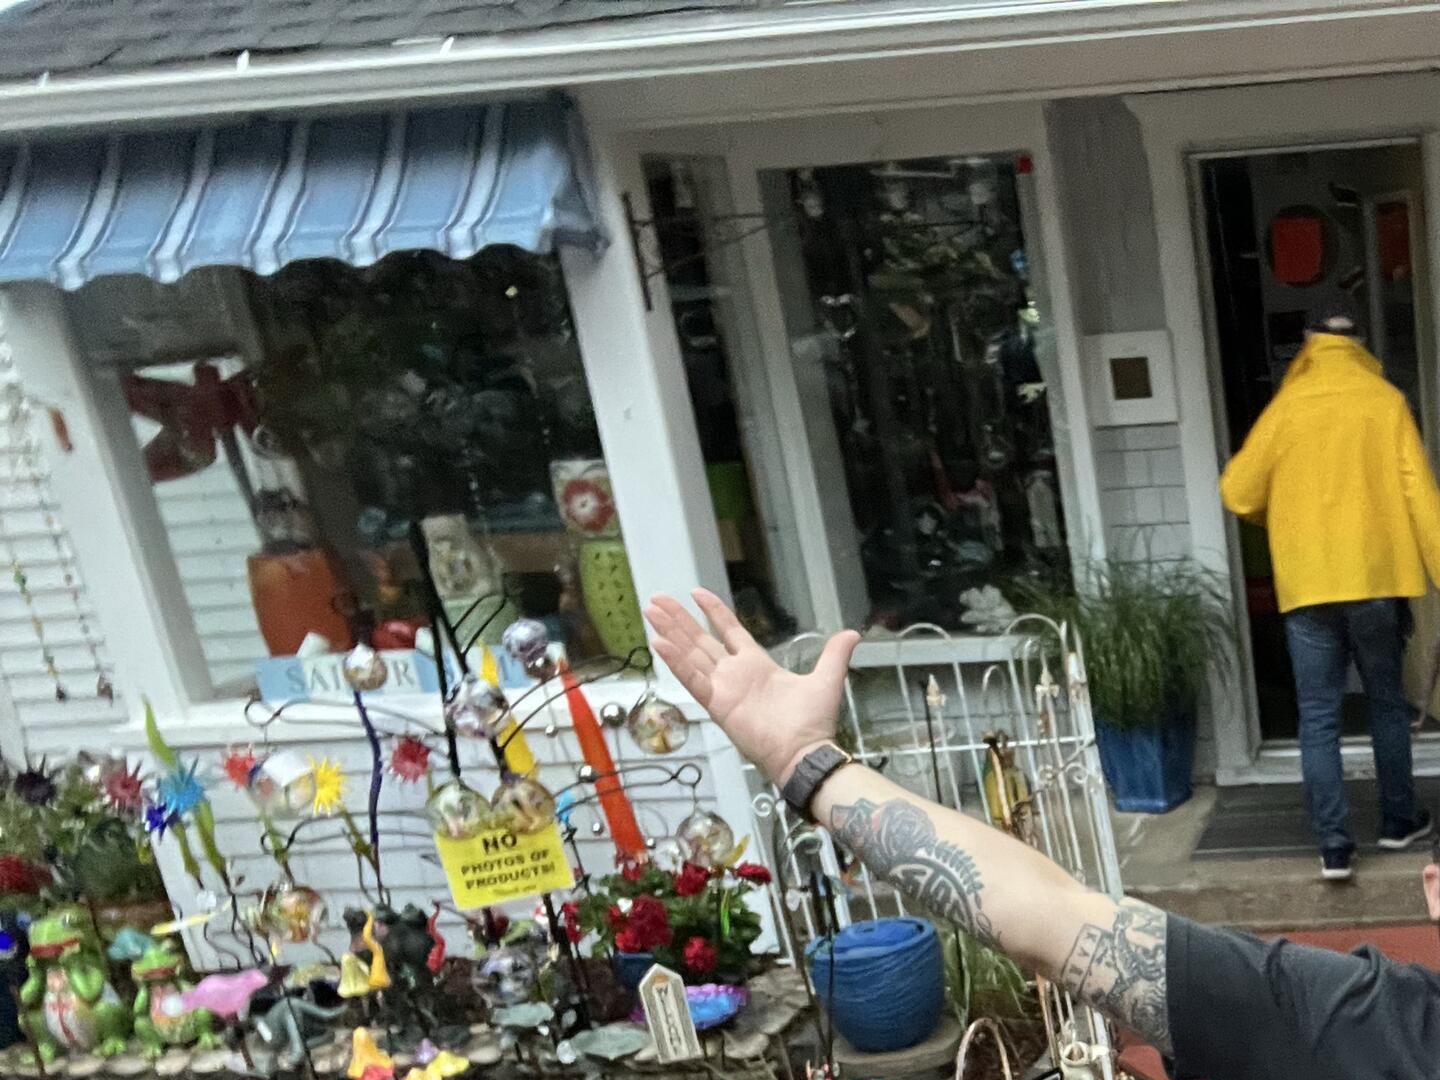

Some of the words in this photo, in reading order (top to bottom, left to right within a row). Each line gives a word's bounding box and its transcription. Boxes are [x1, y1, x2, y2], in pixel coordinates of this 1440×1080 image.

[482, 833, 518, 855] NO
[461, 854, 525, 876] PHOTOS
[530, 848, 549, 861] OF
